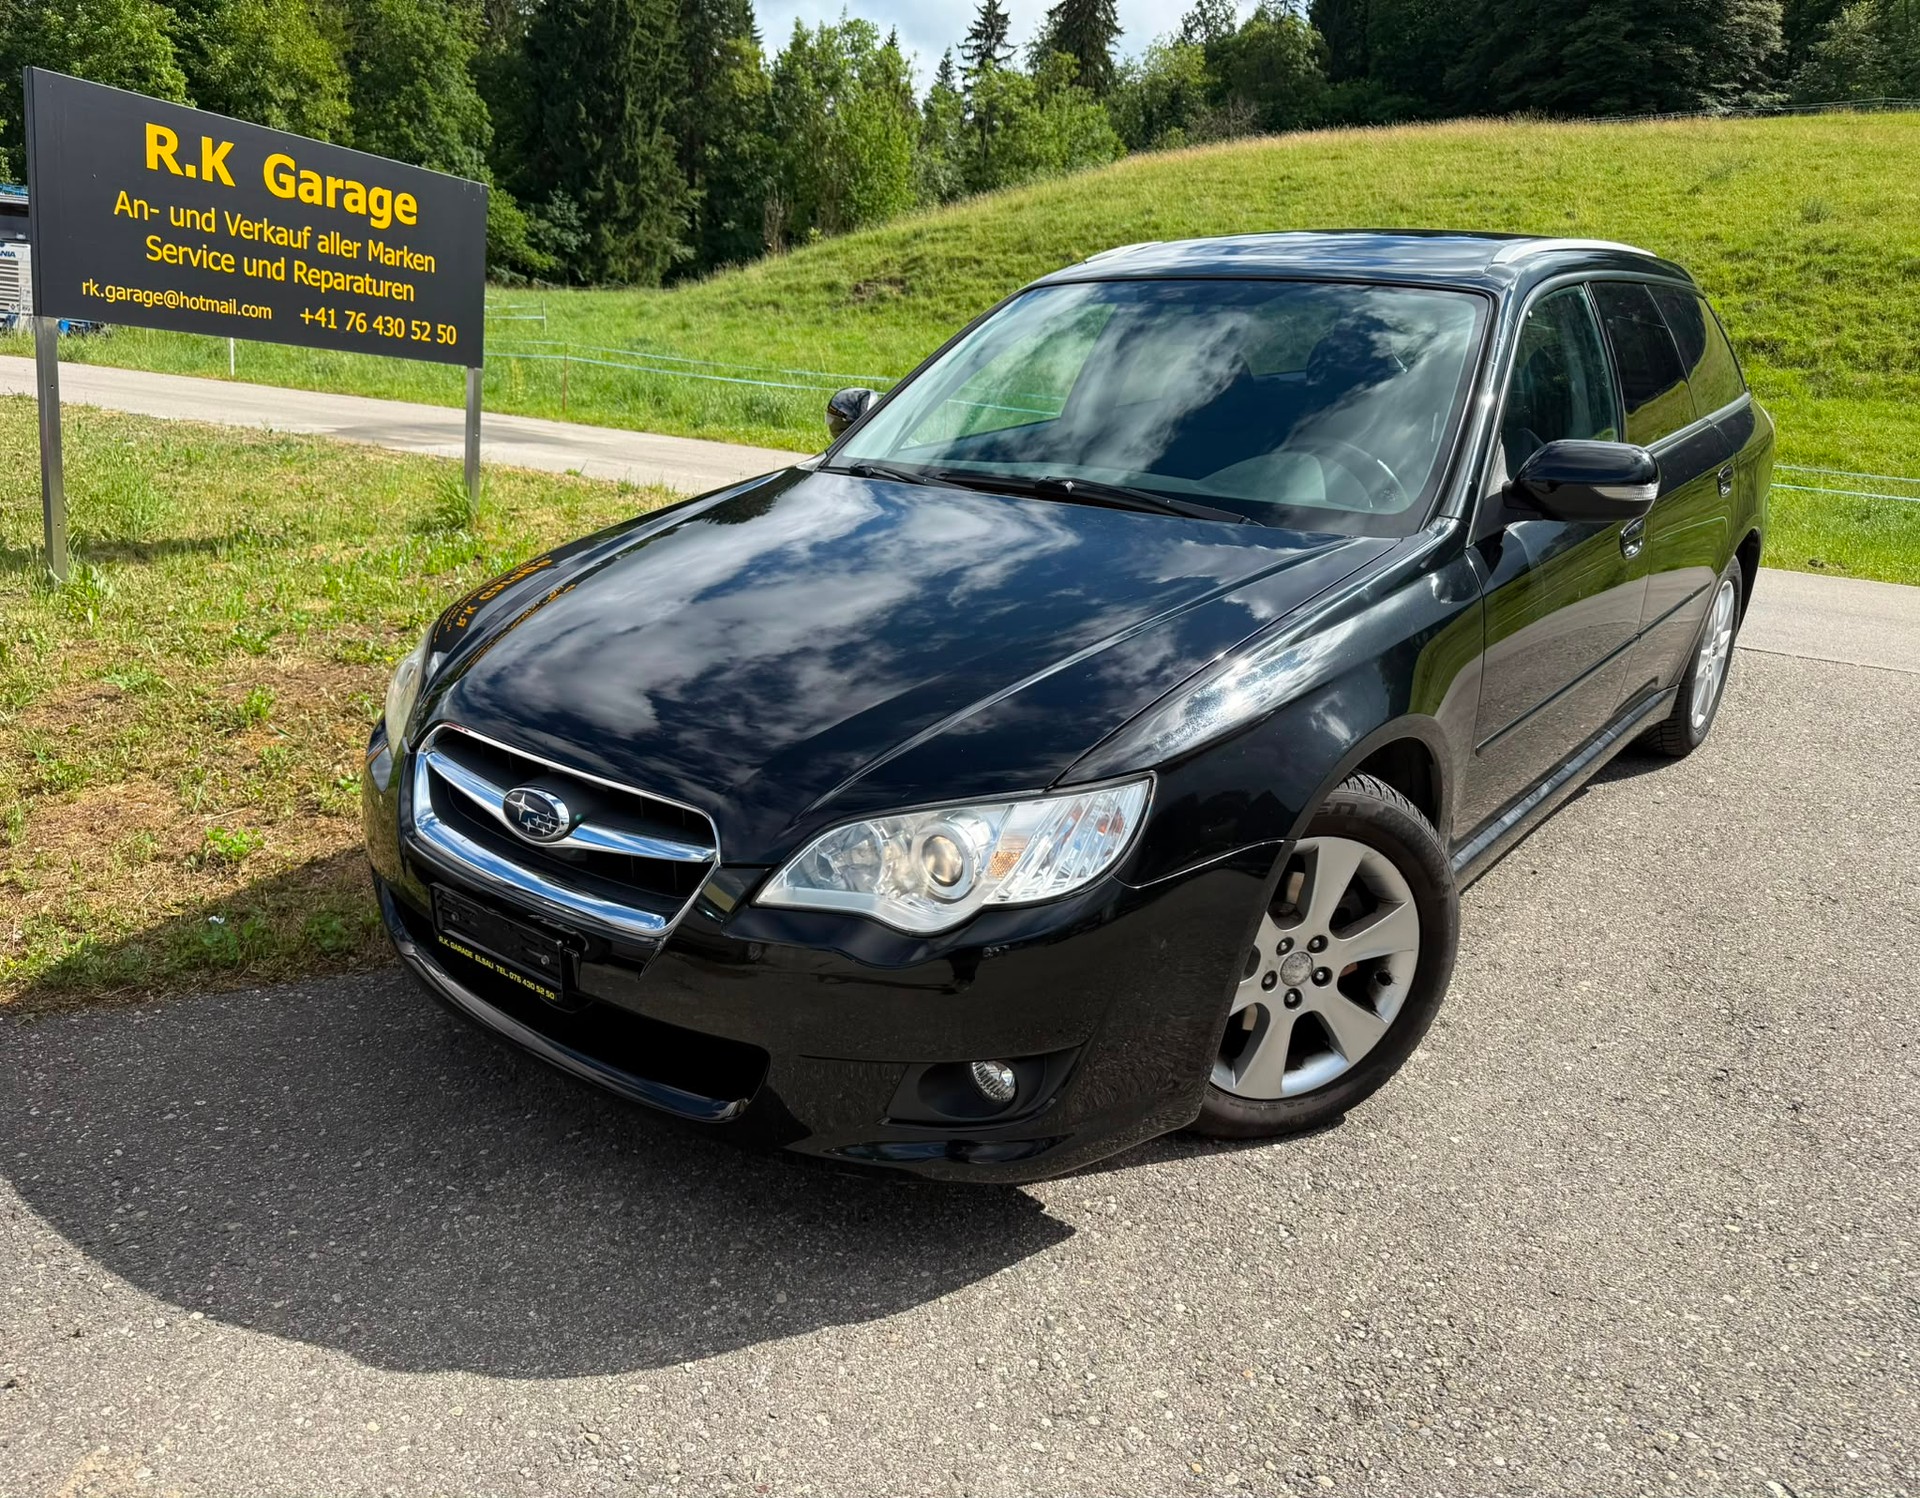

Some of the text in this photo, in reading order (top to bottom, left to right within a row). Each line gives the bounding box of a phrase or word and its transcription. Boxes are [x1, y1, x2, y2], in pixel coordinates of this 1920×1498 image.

[145, 122, 418, 229] R.K Garage
[113, 191, 436, 273] An- und Verkauf aller Marken
[82, 279, 273, 320] rk.garage@hotmail.com
[145, 235, 415, 302] Service und Reparaturen
[299, 306, 458, 346] +41 76 430 52 50
[450, 942, 473, 958] GARAGE
[495, 965, 508, 977] TEL.
[522, 978, 536, 991] 430
[535, 985, 545, 996] 52
[545, 990, 555, 1000] 50
